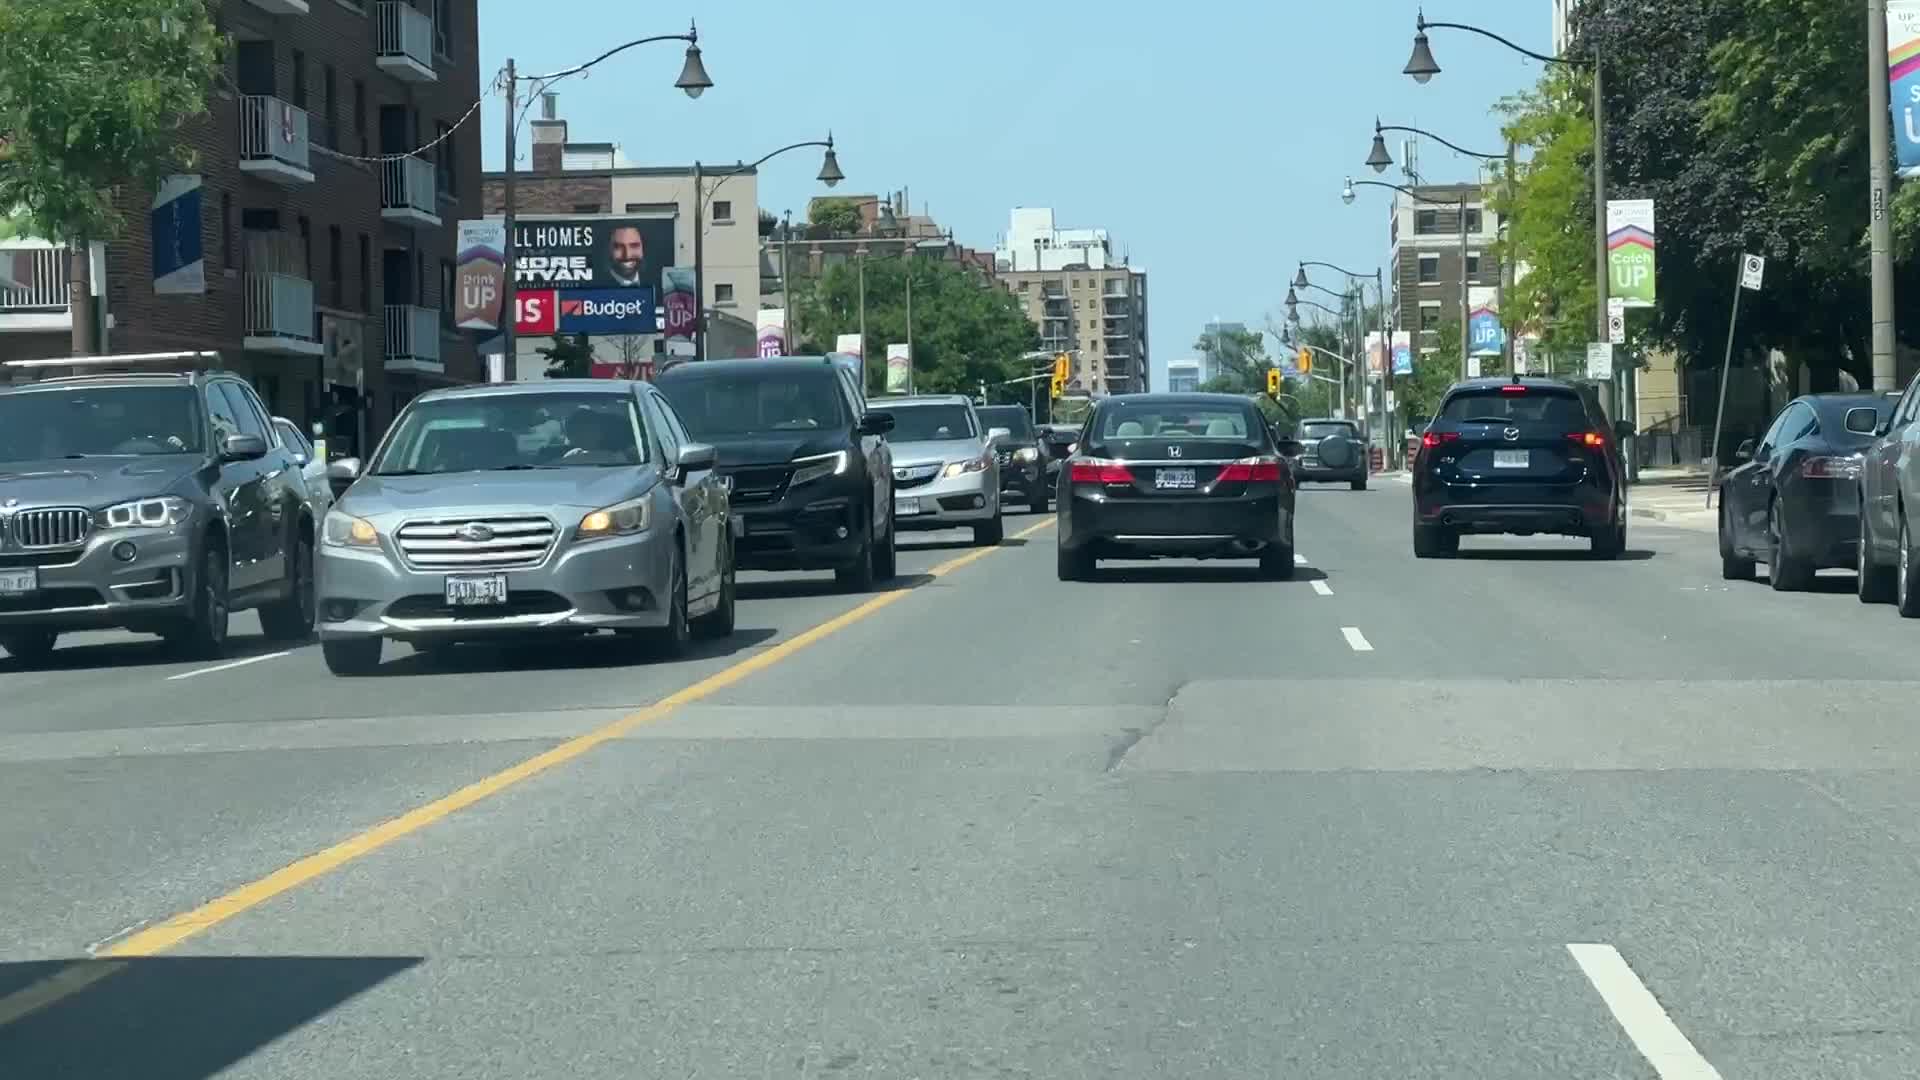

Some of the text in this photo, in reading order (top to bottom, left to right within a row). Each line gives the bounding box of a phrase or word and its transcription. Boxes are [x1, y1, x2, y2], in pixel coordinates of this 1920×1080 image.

[537, 226, 592, 247] HOMES
[1611, 251, 1651, 265] Catch
[464, 273, 495, 285] Drink
[1615, 265, 1648, 288] UP
[464, 286, 496, 309] UP
[584, 299, 642, 320] Budget
[669, 309, 693, 328] UP
[1475, 328, 1496, 343] UP
